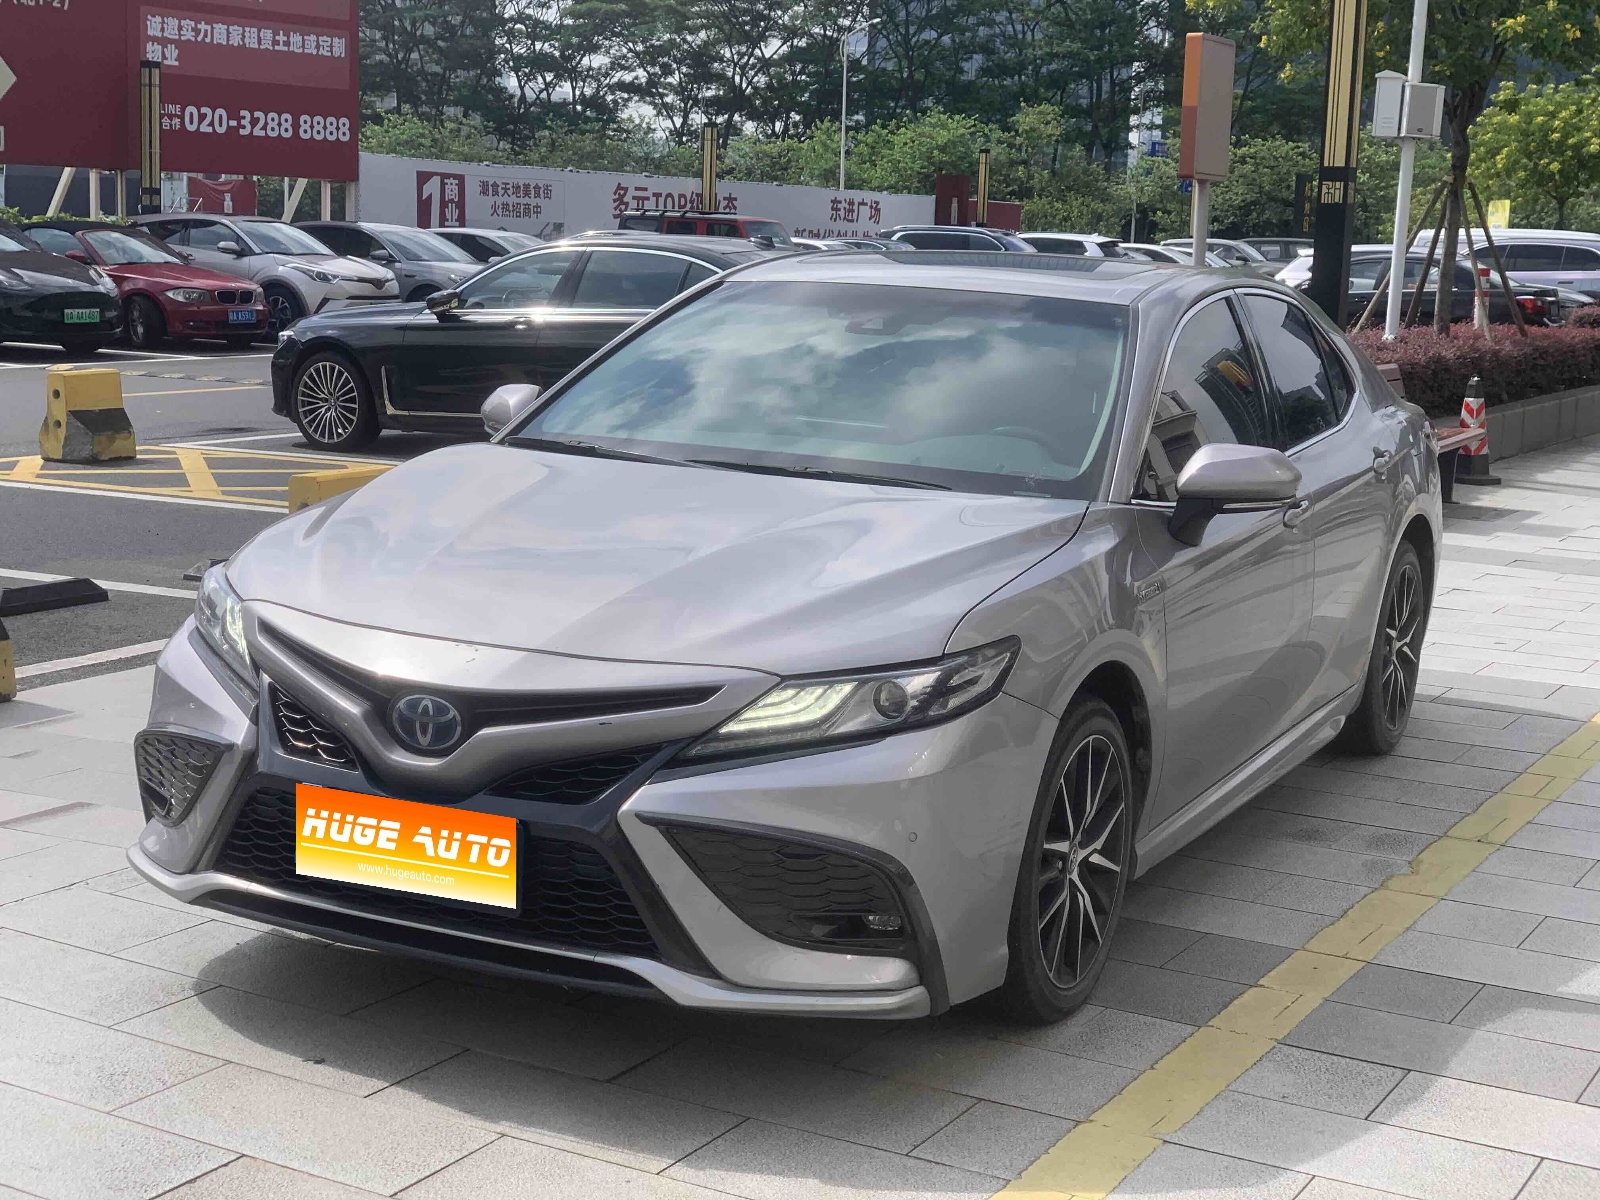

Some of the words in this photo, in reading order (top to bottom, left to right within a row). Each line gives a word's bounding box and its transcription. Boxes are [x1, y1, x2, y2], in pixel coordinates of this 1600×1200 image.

[146, 14, 346, 58] 诚邀实力商家租赁土地或定制
[146, 41, 179, 66] 物业
[184, 105, 293, 138] 020-3288
[299, 114, 351, 142] 8888
[444, 176, 460, 227] 商业
[478, 179, 553, 201] 潮食天地美食街
[490, 200, 542, 220] 火热招商中
[829, 196, 882, 225] 东进广场
